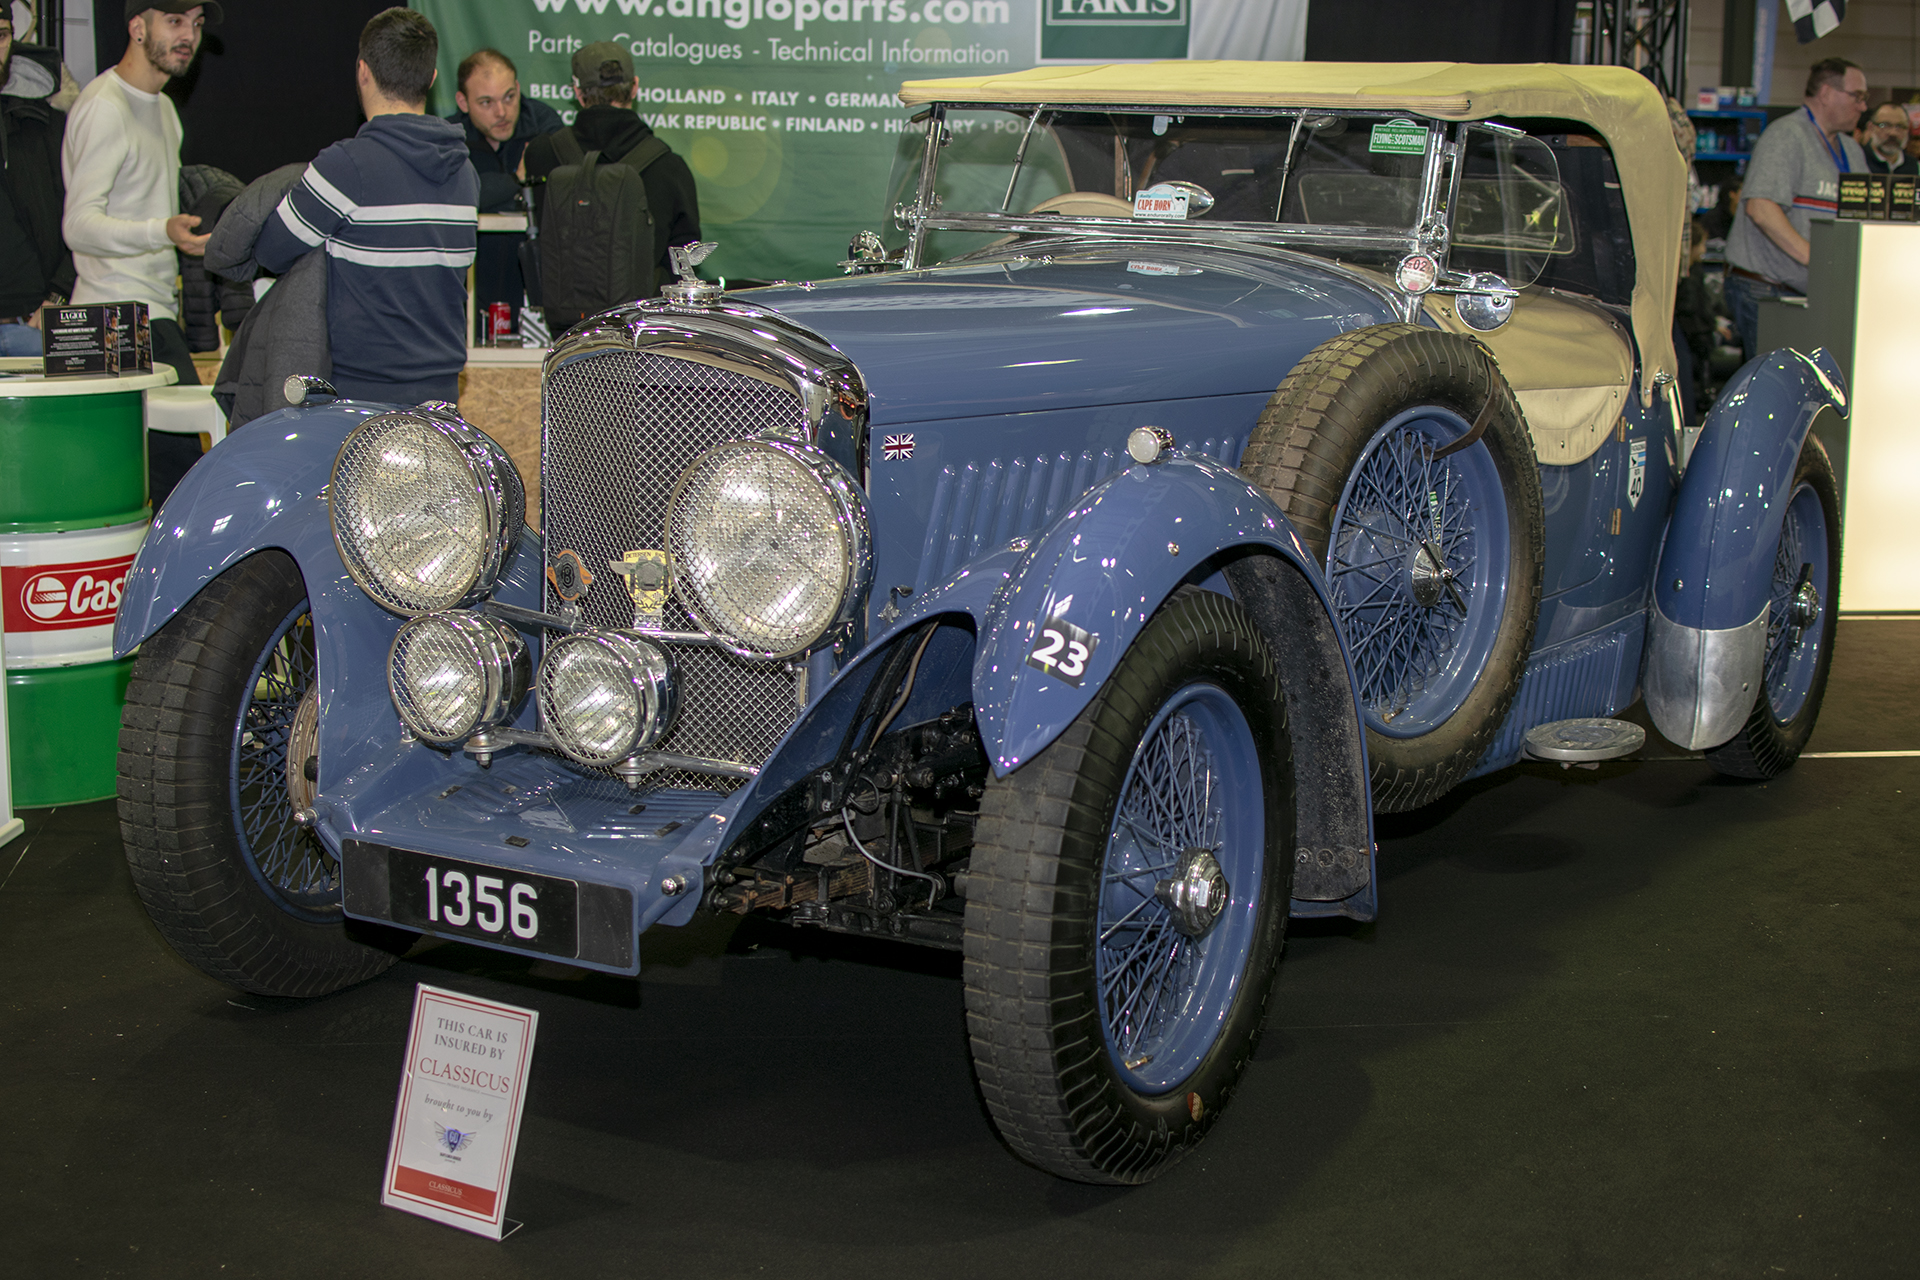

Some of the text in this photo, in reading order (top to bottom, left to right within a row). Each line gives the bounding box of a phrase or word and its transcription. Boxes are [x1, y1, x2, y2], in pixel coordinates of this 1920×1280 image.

[529, 30, 1009, 65] Parts atalogues Technical Information
[530, 83, 906, 108] BELG HOLLAND ITALY GERMAN
[684, 114, 767, 131] REPUBLIC
[786, 117, 865, 133] FINLAND
[884, 118, 976, 134] HUNARY
[1374, 133, 1392, 145] FLYING
[1394, 133, 1426, 146] SCOTSMAN
[1137, 199, 1171, 211] CAPE HORN
[1630, 476, 1642, 499] 40
[69, 574, 127, 615] Cas
[1031, 629, 1089, 677] 23
[425, 867, 539, 939] 1356
[437, 1017, 508, 1043] THIS CAR IS
[434, 1034, 505, 1060] INSURED BY
[420, 1057, 511, 1093] CLASSICUS
[424, 1093, 455, 1111] brought
[464, 1108, 481, 1117] you
[483, 1108, 493, 1122] by
[428, 1180, 464, 1196] CLASSICUS
